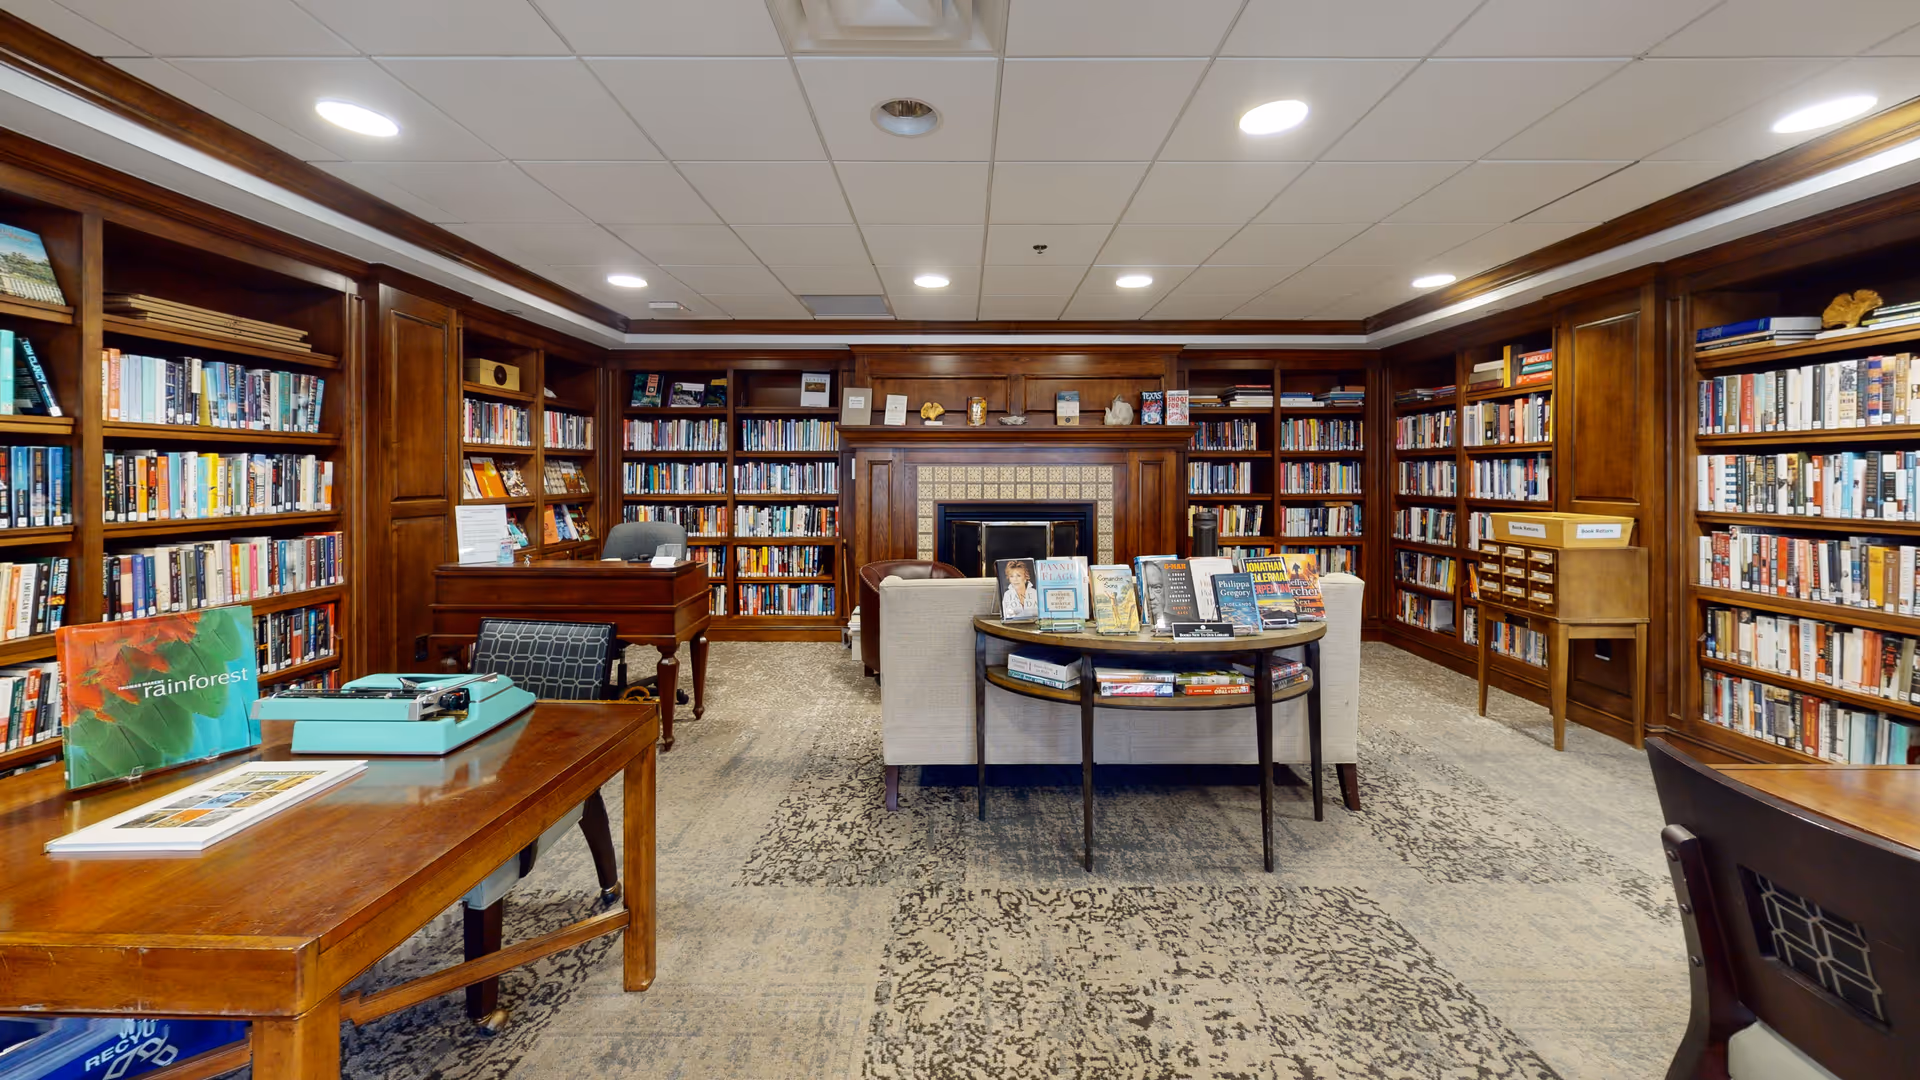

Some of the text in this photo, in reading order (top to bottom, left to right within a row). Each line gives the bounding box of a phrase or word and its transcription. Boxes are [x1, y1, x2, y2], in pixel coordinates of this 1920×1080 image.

[1142, 391, 1162, 400] TEXAS
[1246, 561, 1284, 573] JONATHAN
[1096, 574, 1124, 582] Comanche
[1252, 571, 1288, 583] ELLERMAN
[1218, 580, 1250, 590] Philippa
[1289, 578, 1313, 587] effrey
[1220, 589, 1251, 599] Gregory
[1290, 586, 1319, 596] rcher
[1009, 592, 1033, 601] JANE
[117, 680, 165, 691] THOMAS MARENT
[144, 667, 249, 699] rainforest
